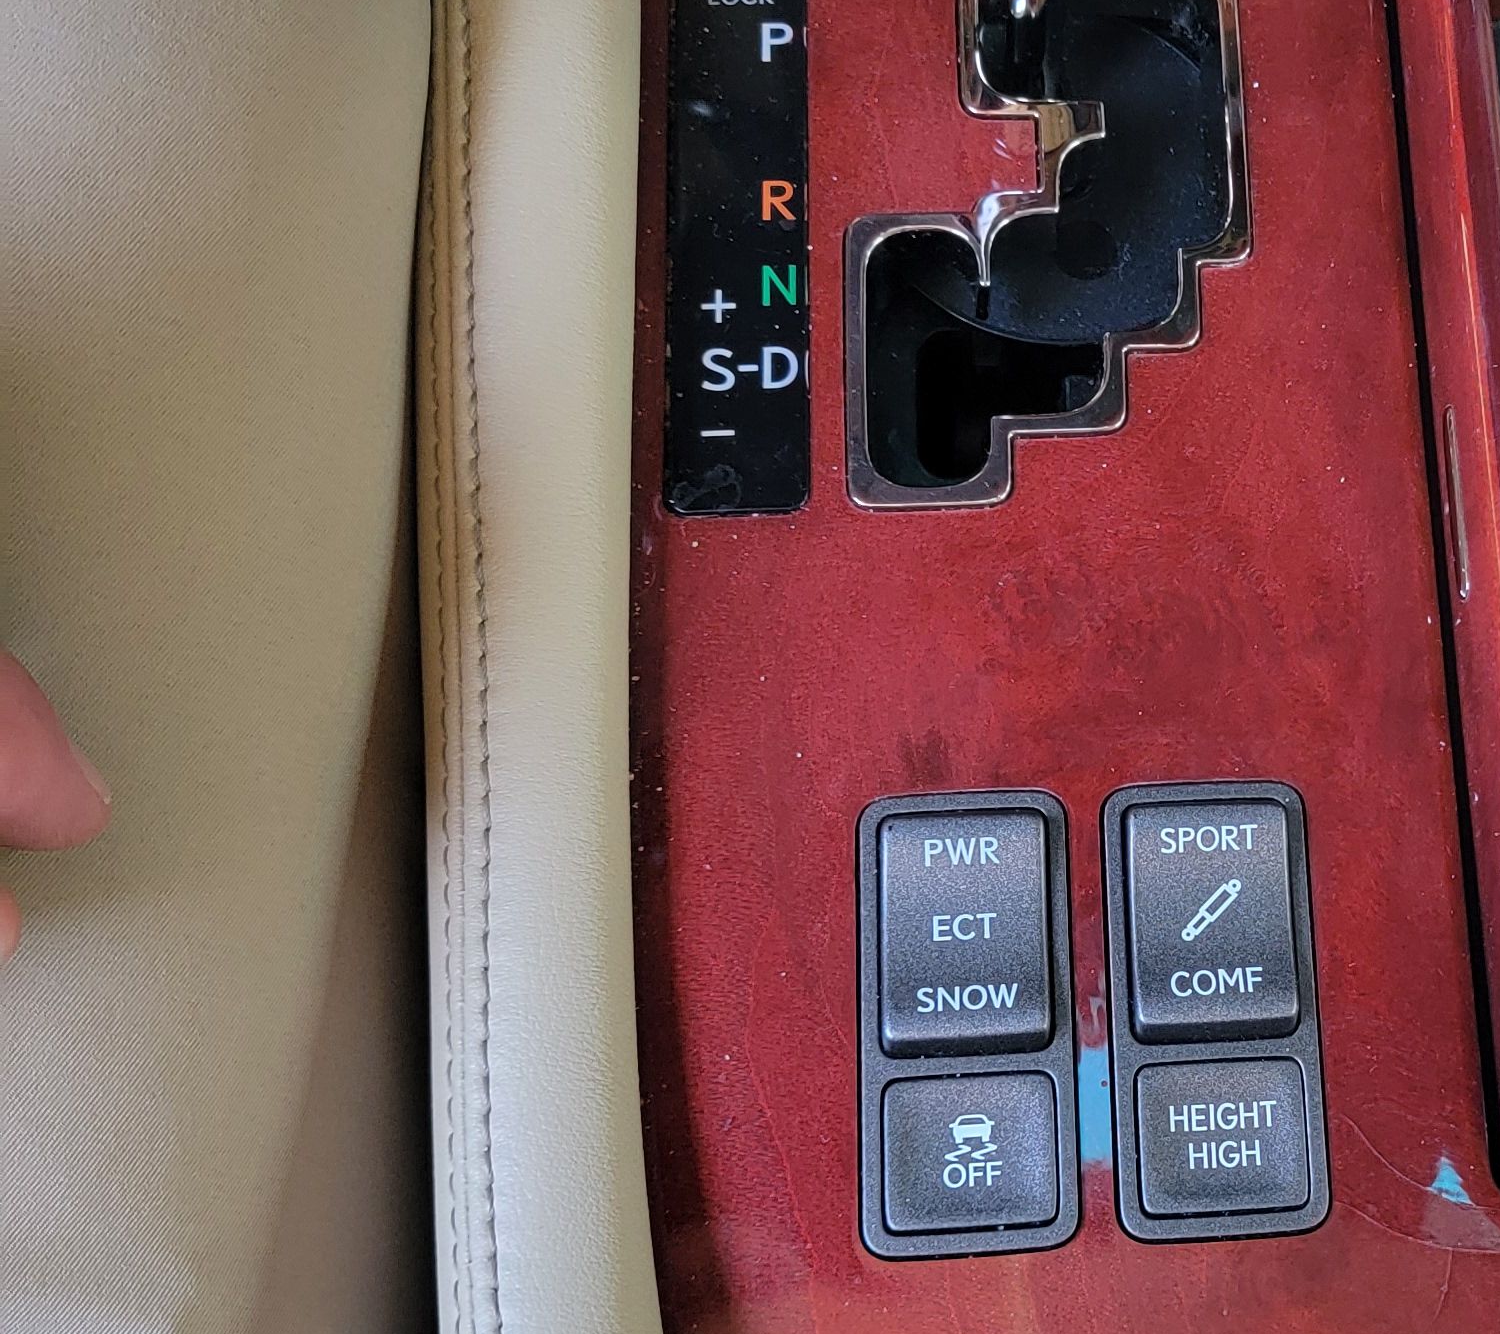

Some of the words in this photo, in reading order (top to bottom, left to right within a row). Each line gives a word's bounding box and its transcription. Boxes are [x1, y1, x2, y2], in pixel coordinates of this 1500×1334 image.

[760, 22, 794, 63] P
[761, 179, 797, 221] R
[761, 264, 797, 307] N
[924, 836, 1000, 867] PWR
[1160, 824, 1258, 854] SPORT
[932, 912, 998, 942] ECT
[1170, 967, 1264, 998] COMF
[916, 983, 1019, 1014] SNOW
[1168, 1100, 1277, 1133] HEIGHT
[1188, 1140, 1262, 1170] HIGH
[942, 1160, 1003, 1189] OFF
